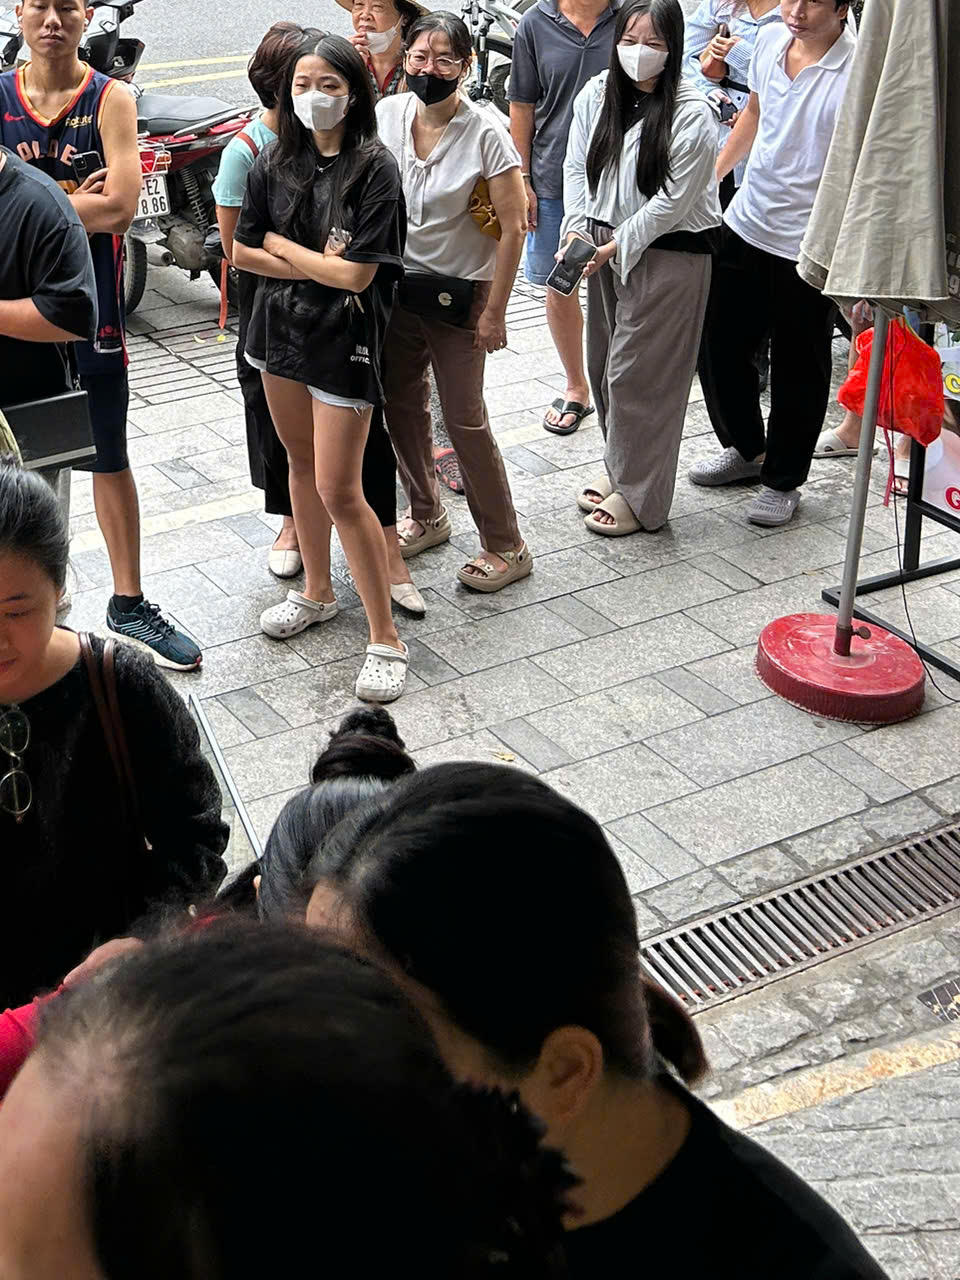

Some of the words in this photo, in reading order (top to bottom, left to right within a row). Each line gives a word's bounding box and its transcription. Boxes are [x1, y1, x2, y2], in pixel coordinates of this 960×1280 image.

[16, 139, 77, 167] OLDE
[142, 178, 160, 196] -E2
[136, 196, 167, 216] 8.86
